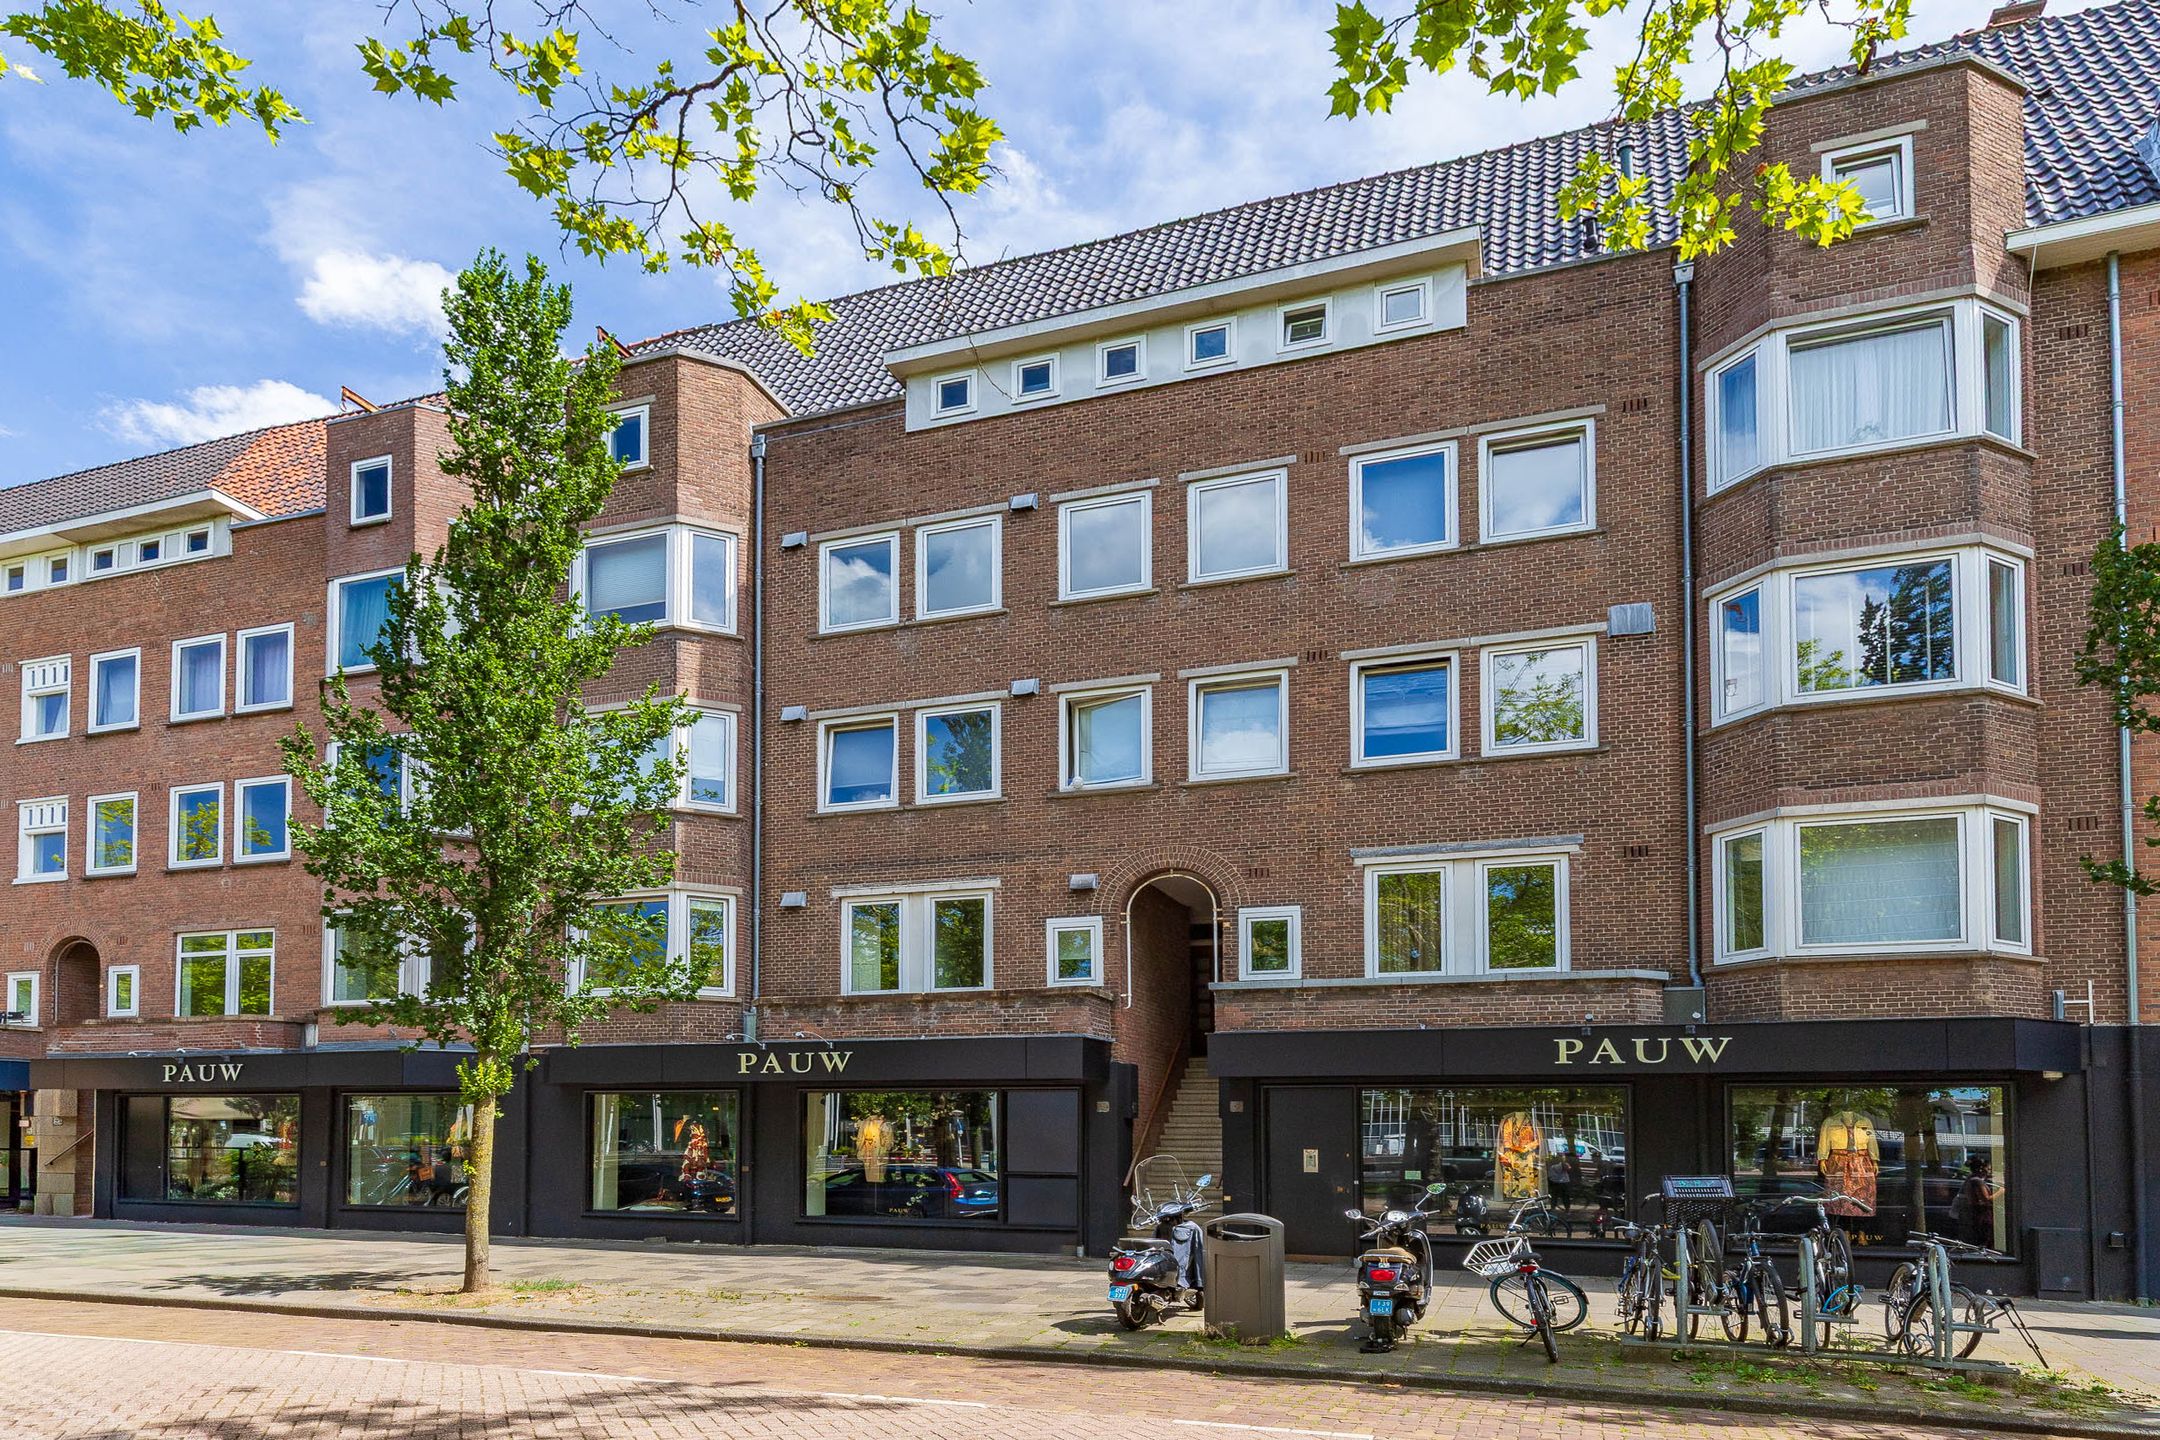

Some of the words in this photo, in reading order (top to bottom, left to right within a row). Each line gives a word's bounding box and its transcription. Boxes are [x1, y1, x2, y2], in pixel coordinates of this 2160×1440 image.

[1553, 1037, 1733, 1064] PAUW
[162, 1063, 244, 1082] PAUW
[737, 1052, 854, 1074] PAUW
